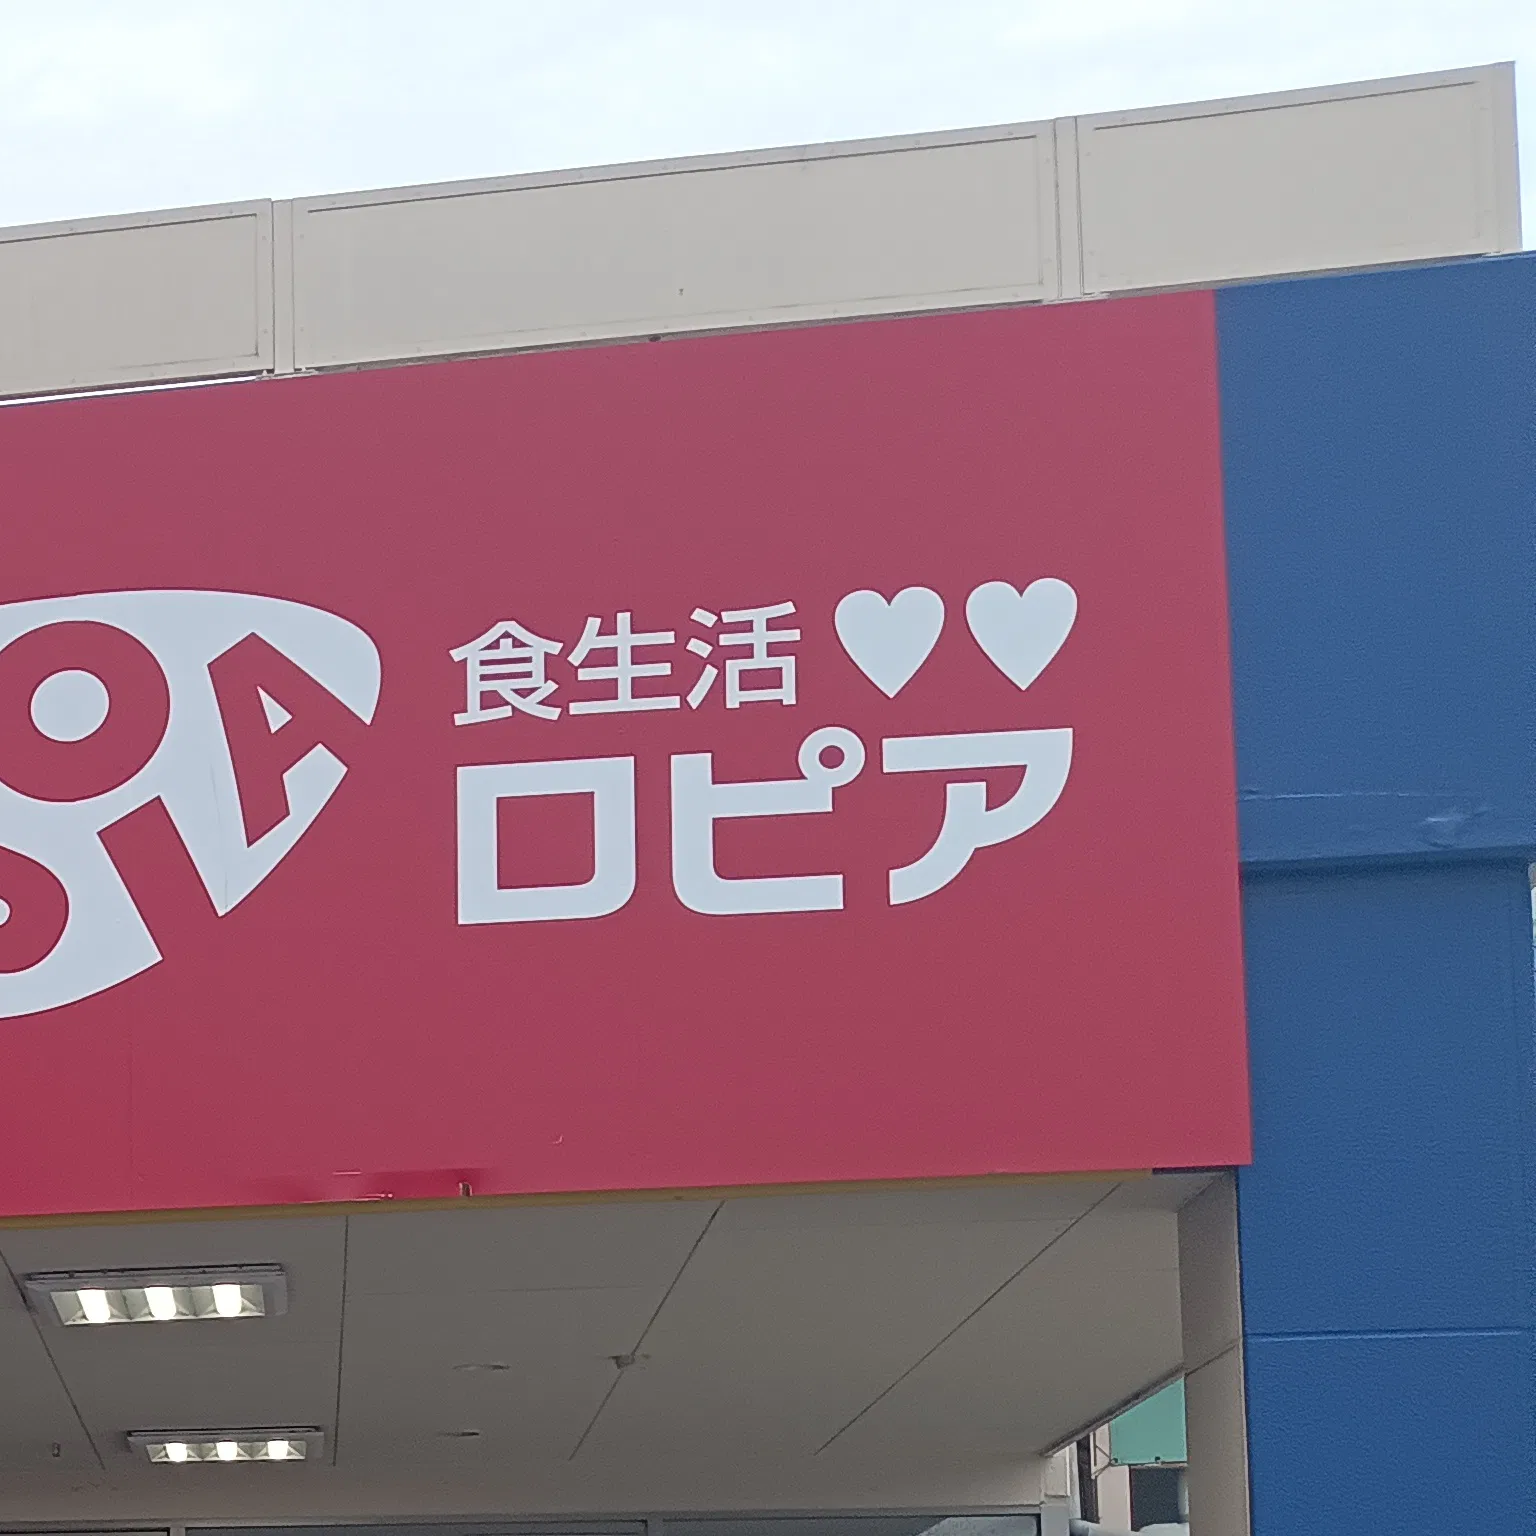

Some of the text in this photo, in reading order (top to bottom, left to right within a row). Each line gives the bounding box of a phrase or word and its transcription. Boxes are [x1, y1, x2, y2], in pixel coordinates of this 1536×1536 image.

[449, 601, 801, 727] 食生活
[456, 726, 1074, 926] ロピア
